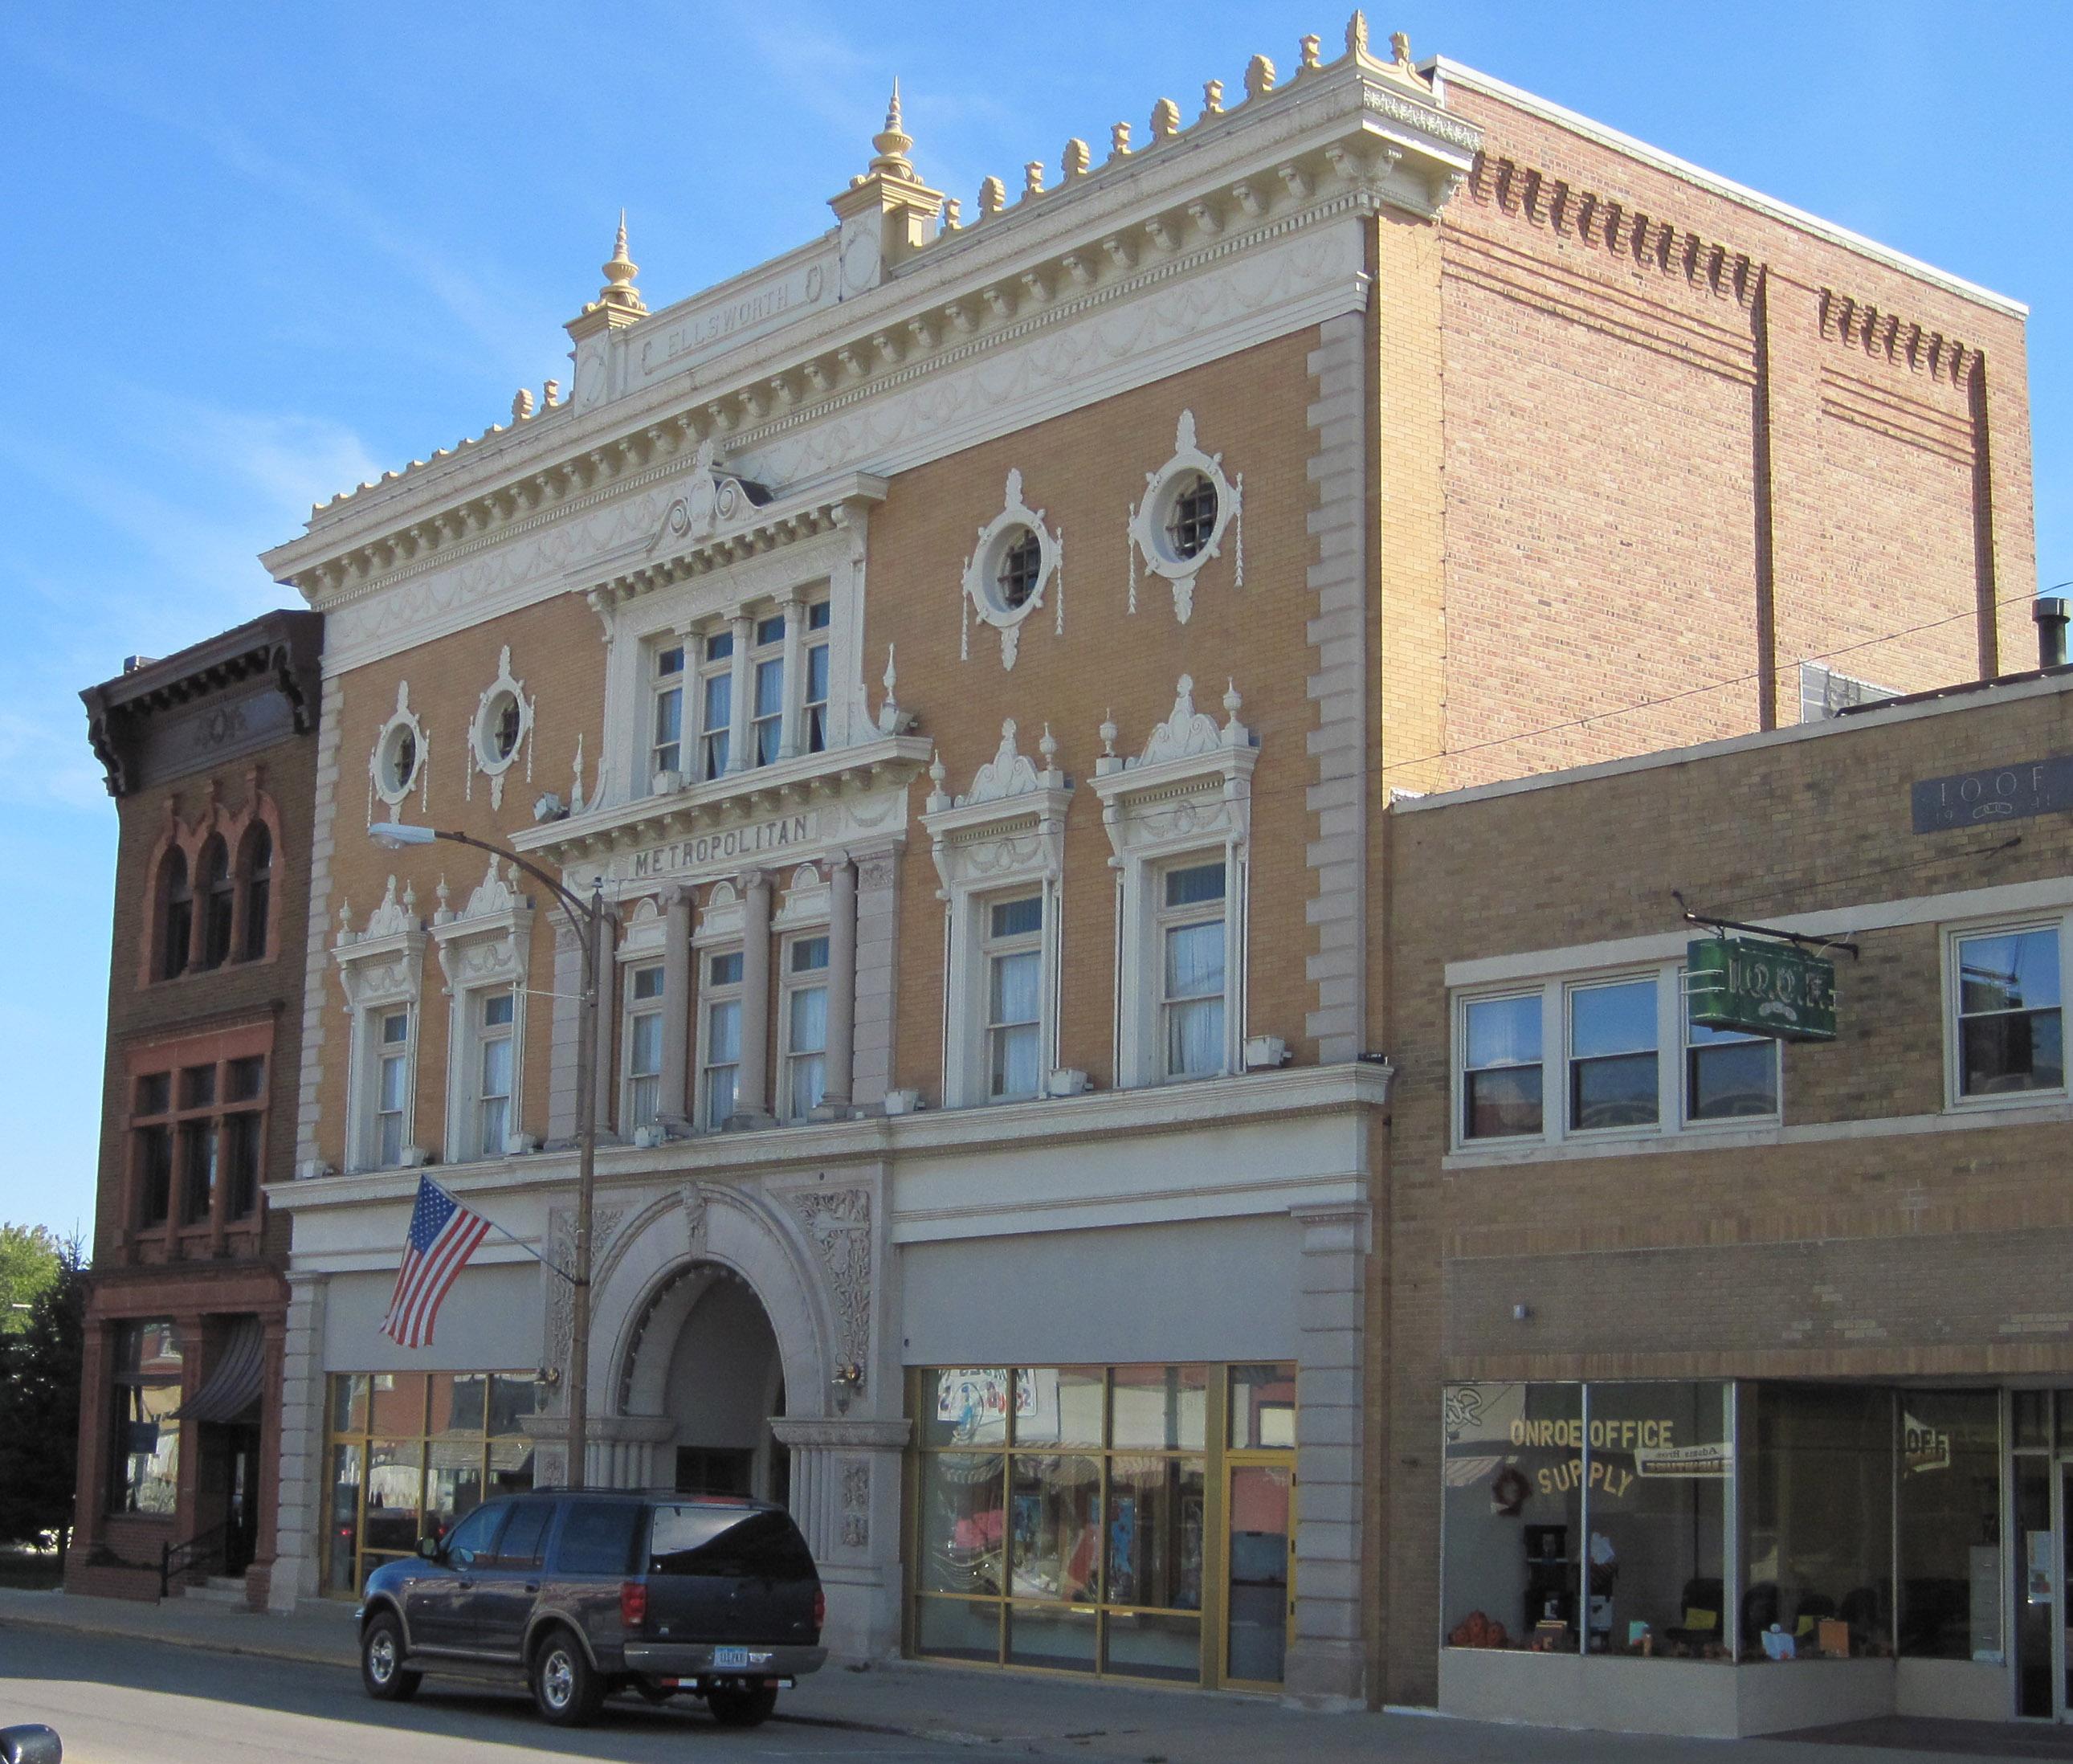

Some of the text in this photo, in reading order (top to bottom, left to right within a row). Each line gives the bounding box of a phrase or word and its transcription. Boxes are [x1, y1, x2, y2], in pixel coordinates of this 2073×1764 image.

[667, 284, 789, 357] ELLSWORTH
[635, 815, 808, 877] METROPOLITAN
[1589, 1419, 1674, 1448] OFFICE
[1537, 1459, 1634, 1497] SUPPLY
